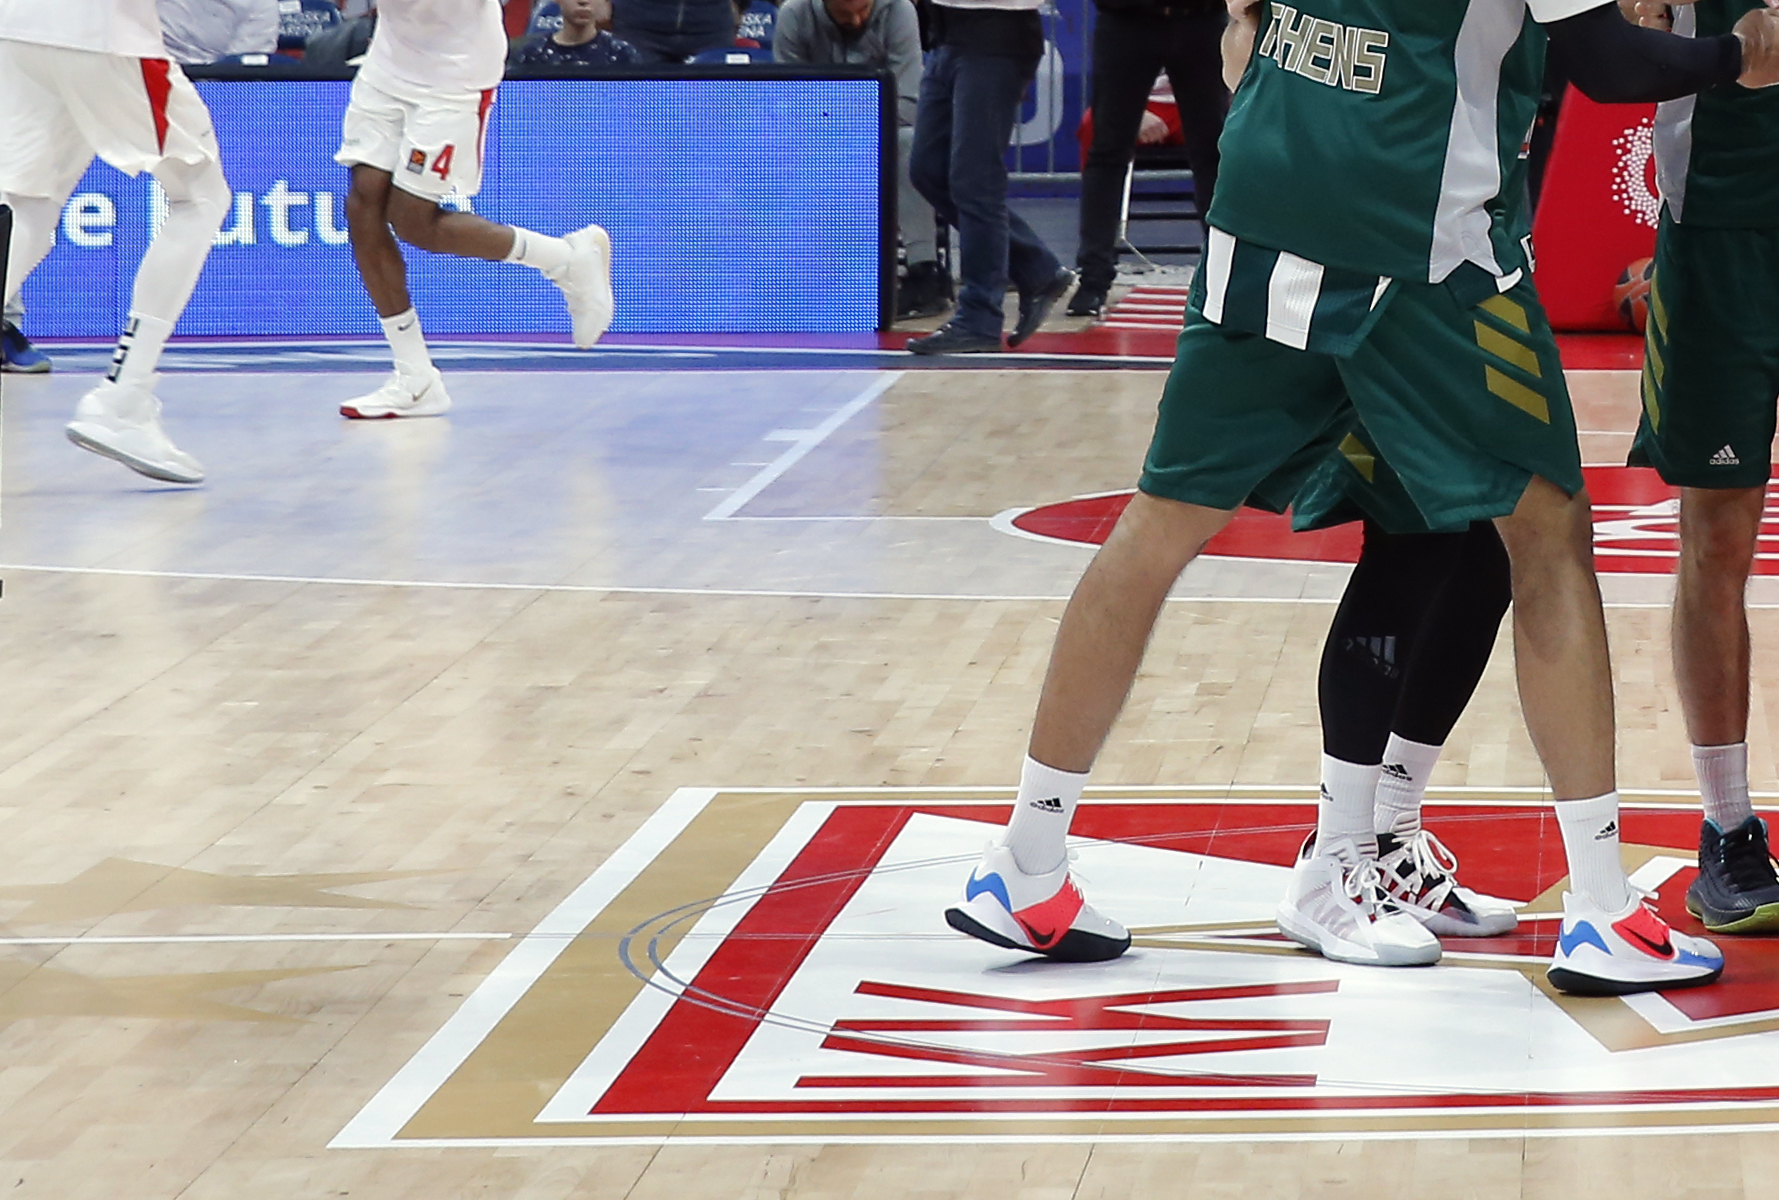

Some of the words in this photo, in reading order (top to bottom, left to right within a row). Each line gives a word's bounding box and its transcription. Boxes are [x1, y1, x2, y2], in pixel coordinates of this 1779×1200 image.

[1258, 1, 1389, 95] THENS
[431, 144, 455, 181] 4
[1709, 457, 1740, 465] adidas
